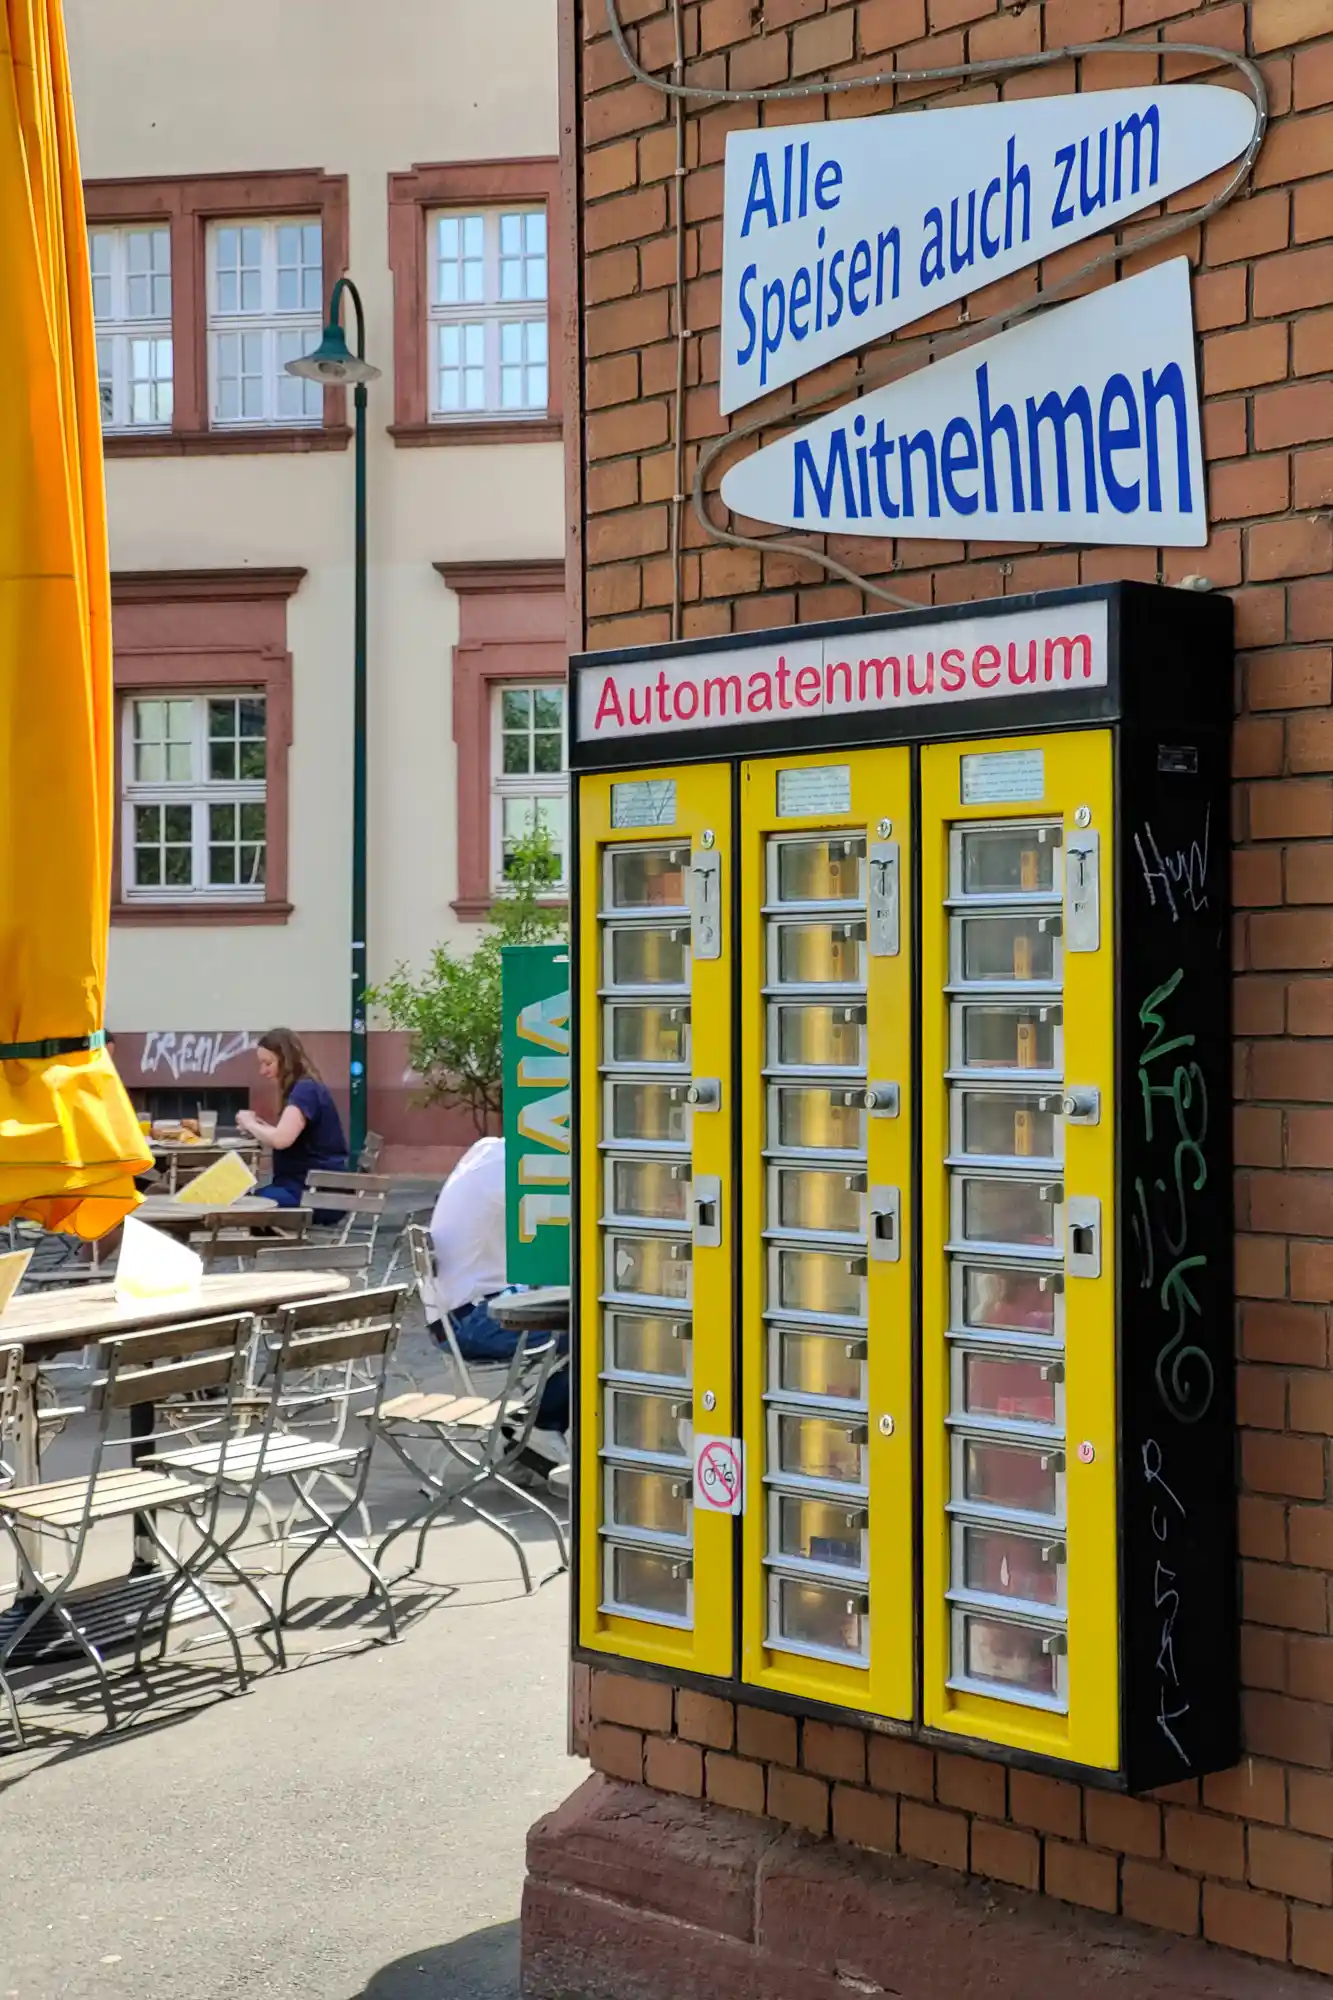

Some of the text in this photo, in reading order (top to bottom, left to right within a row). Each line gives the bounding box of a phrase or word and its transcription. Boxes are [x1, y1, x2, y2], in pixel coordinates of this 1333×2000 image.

[736, 103, 1160, 386] Speisen auch zum
[740, 142, 843, 238] Alle
[793, 361, 1193, 519] Mitnehmen
[594, 633, 1092, 729] Automatenmuseum
